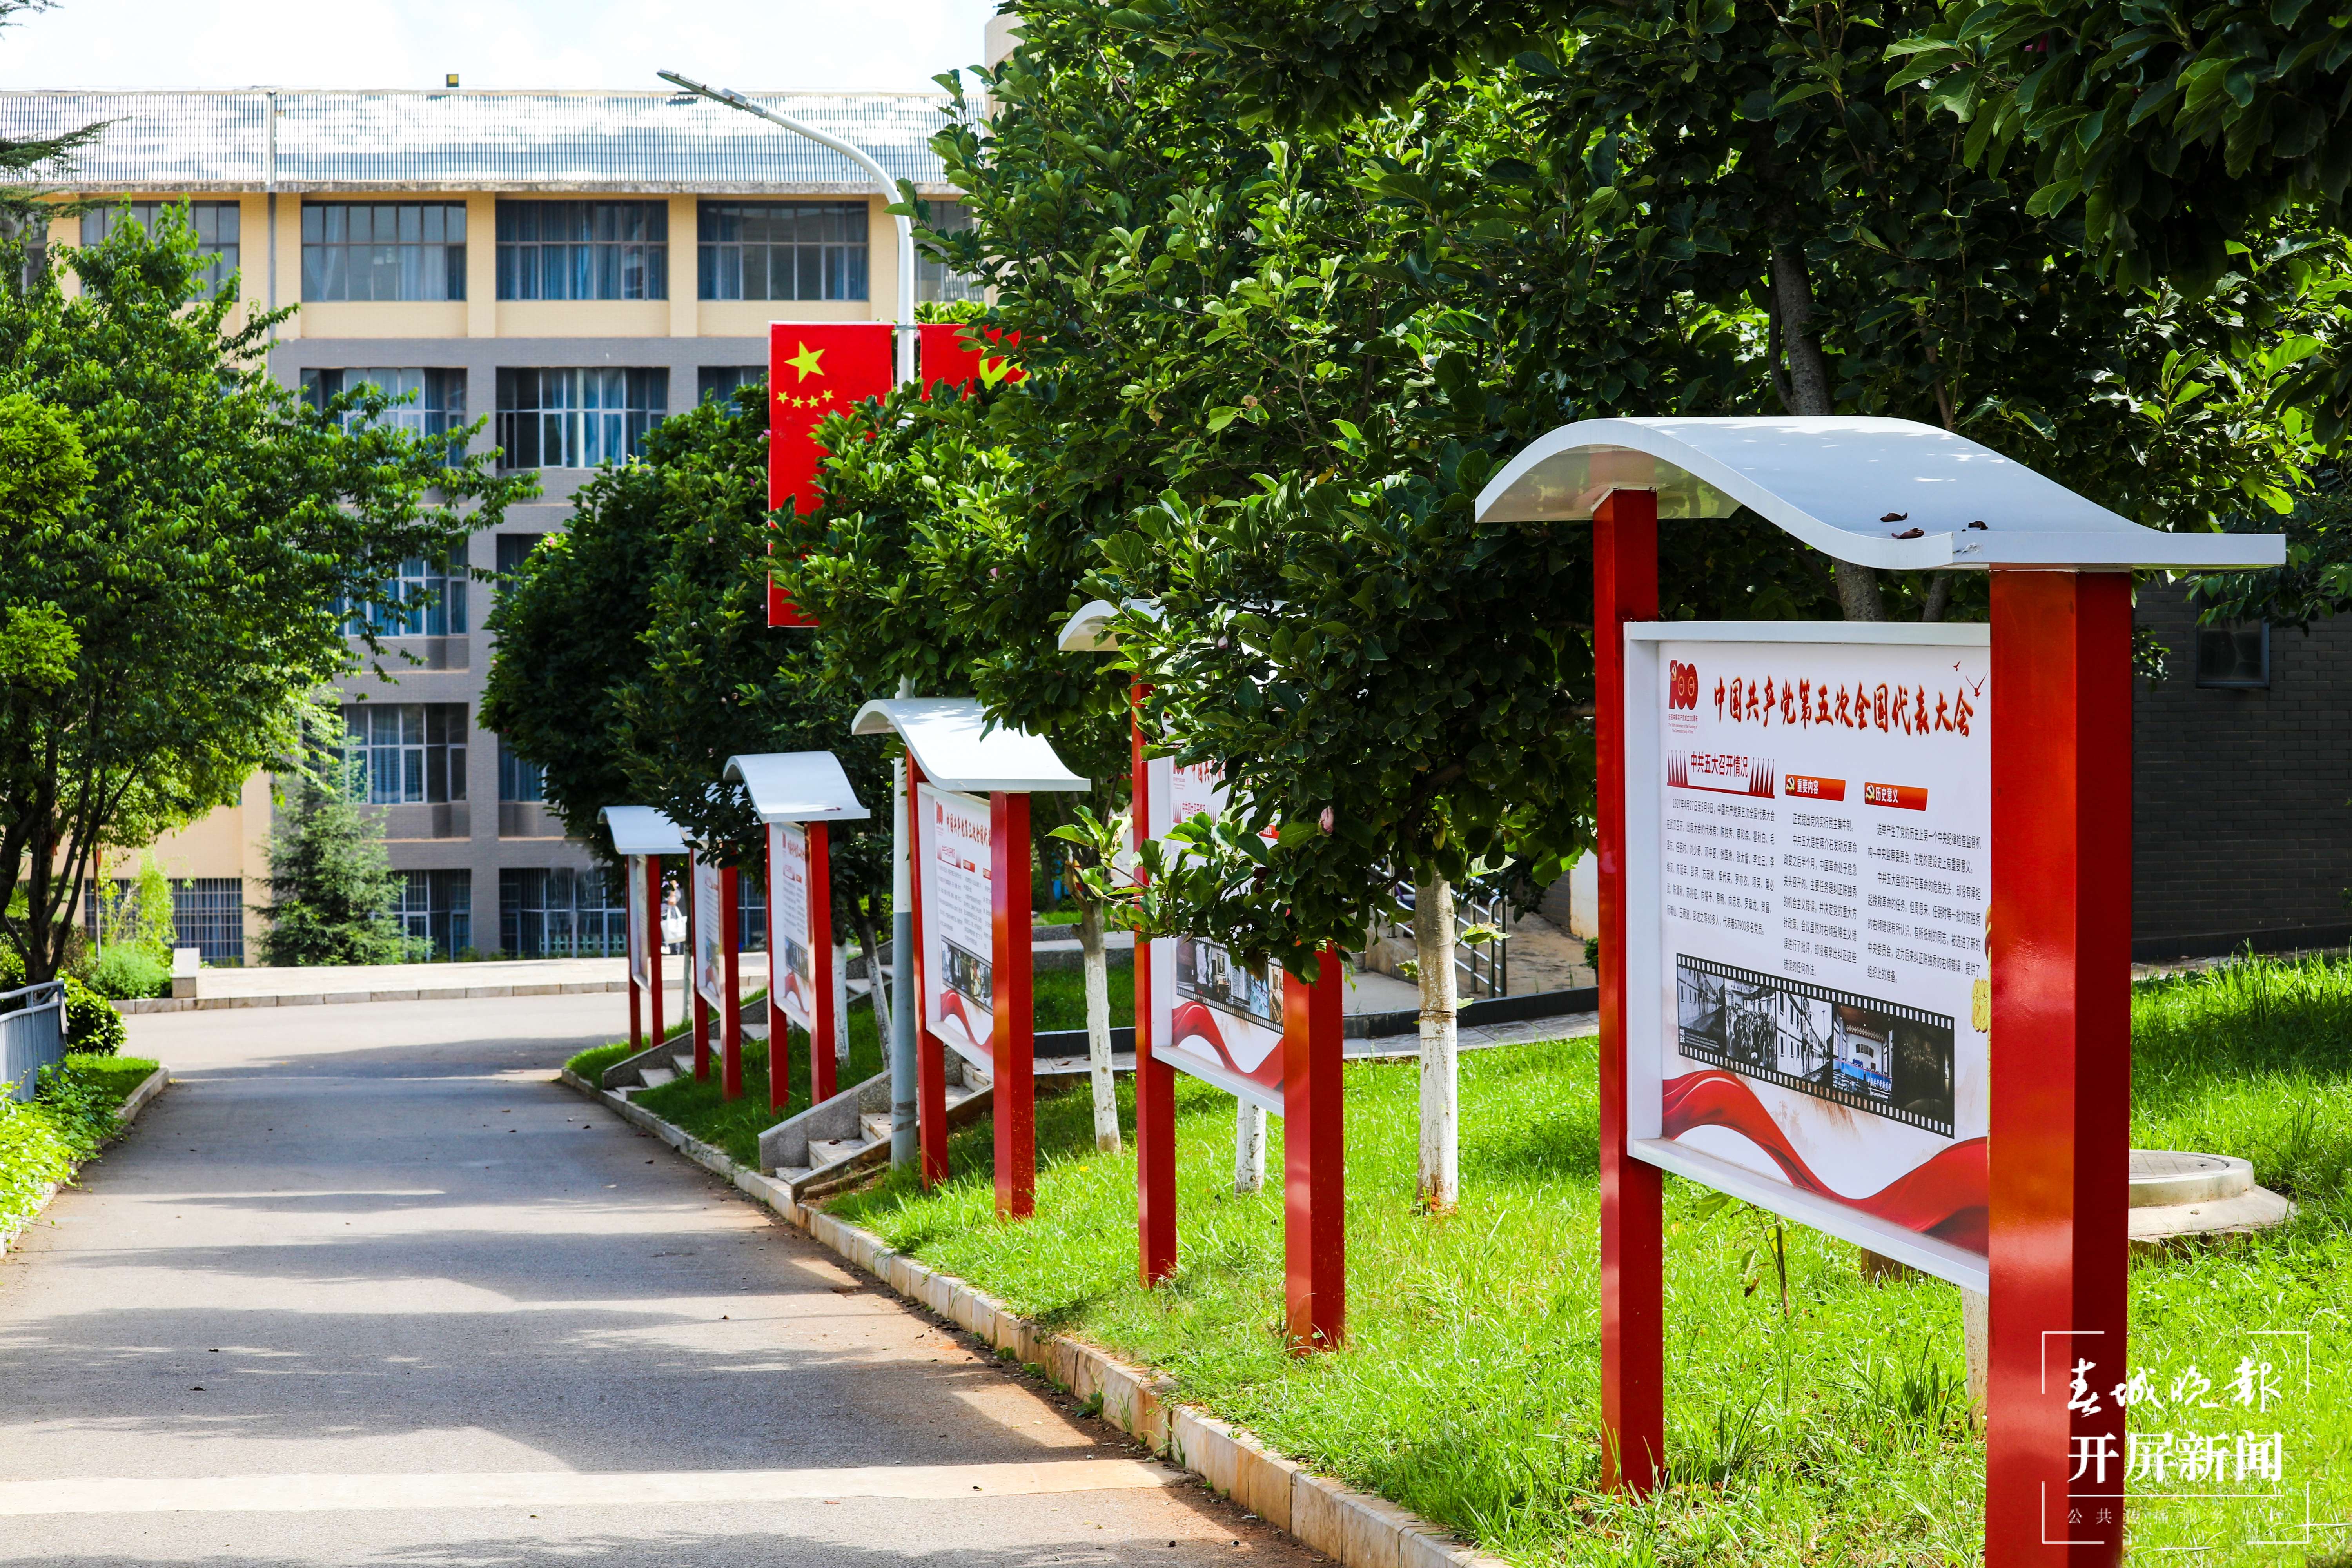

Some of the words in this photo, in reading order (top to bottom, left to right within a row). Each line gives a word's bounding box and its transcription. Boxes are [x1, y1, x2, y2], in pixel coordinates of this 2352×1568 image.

[1714, 674, 1974, 737] 中国共产党第五次全国代表大会
[1691, 751, 1748, 778] 中共五大召开情况
[1797, 778, 1819, 795] 重要内容
[1875, 786, 1898, 803] 历史意义
[1793, 813, 1854, 832] 正式提出党内实行民主集中制。
[1793, 833, 1857, 854] 中共五大是在蒋介石发动反革命
[1867, 965, 1898, 984] 组织上的准备。
